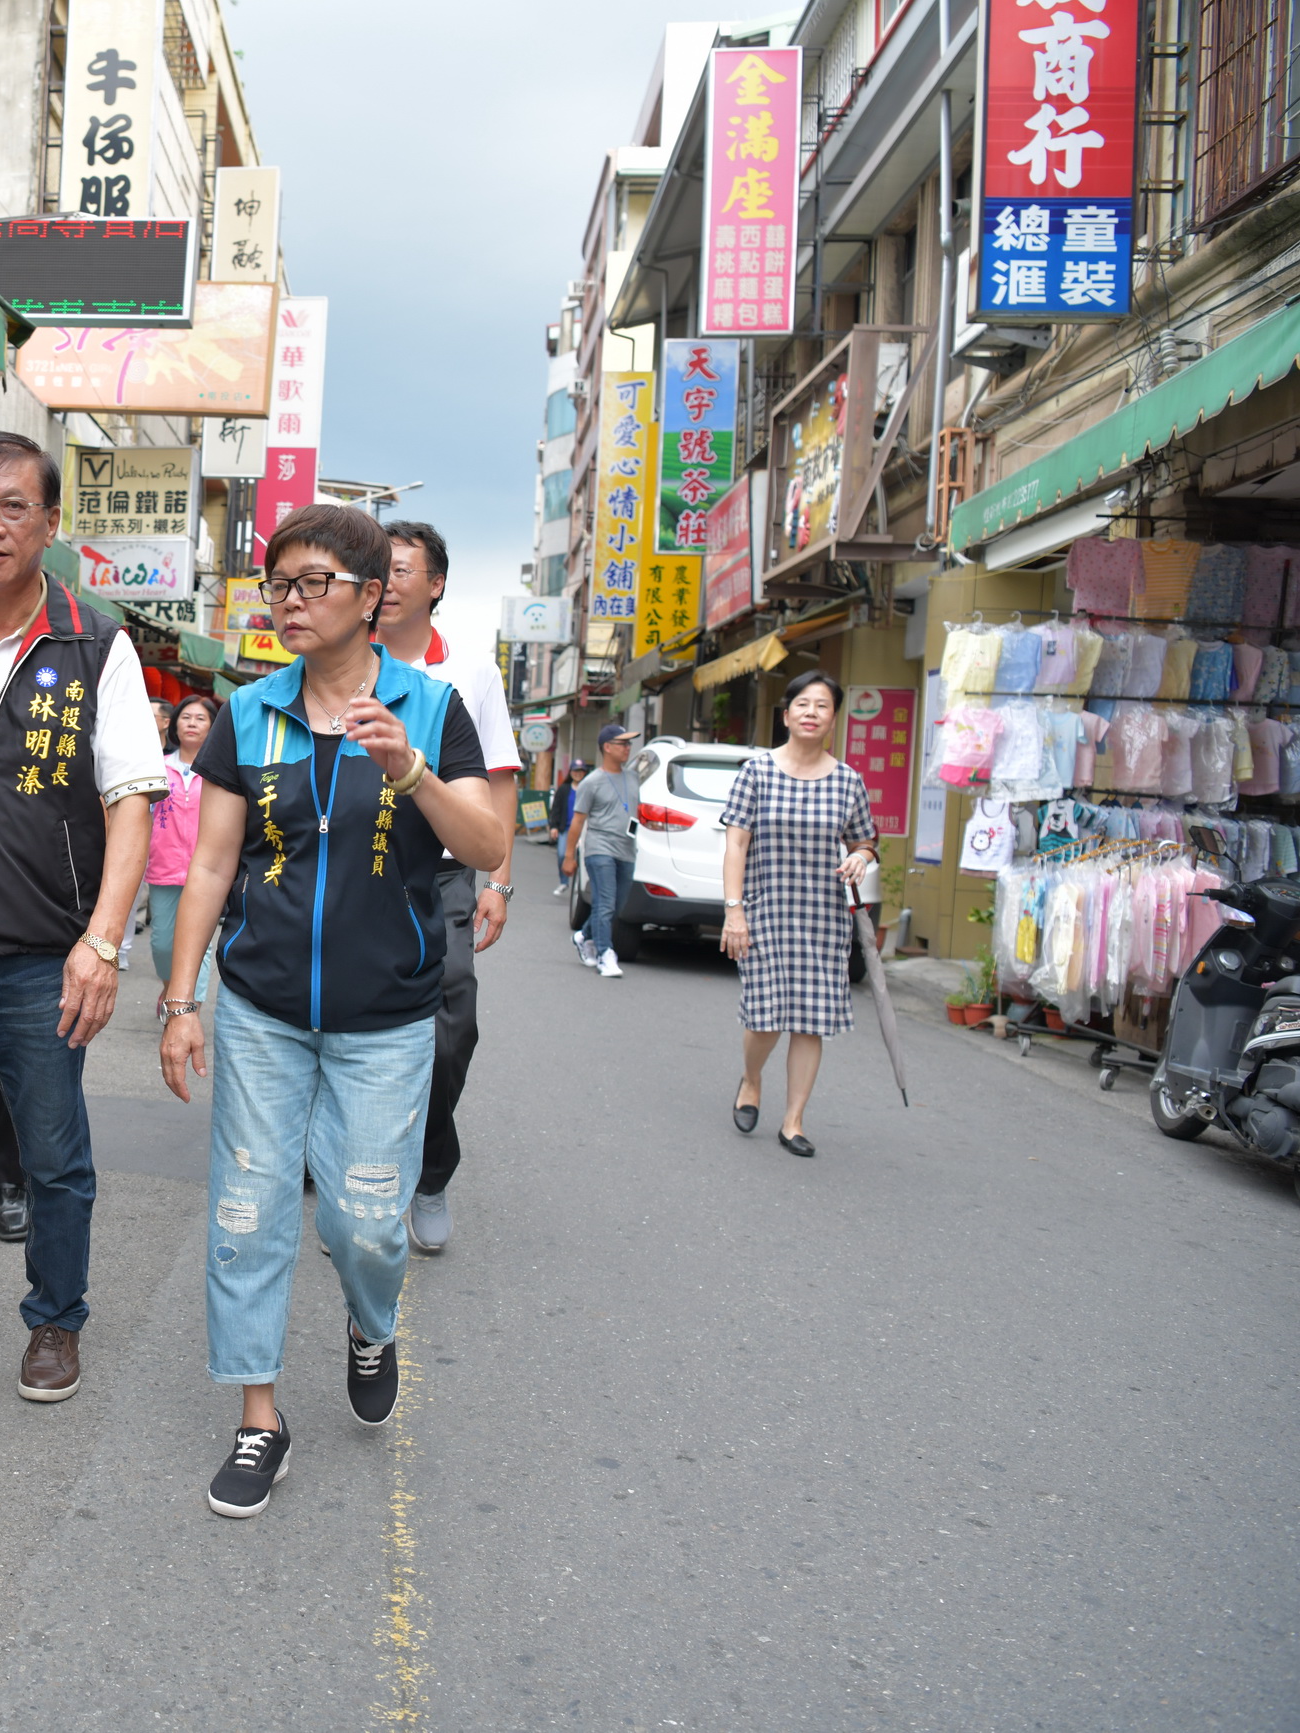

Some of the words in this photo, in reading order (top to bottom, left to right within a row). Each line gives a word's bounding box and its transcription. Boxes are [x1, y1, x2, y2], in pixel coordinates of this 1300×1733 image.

[80, 48, 138, 217] 牛仔服
[721, 53, 788, 220] 金滿座
[1007, 0, 1111, 188] 商行
[1059, 205, 1119, 307] 童裝
[277, 346, 306, 435] 華歌爾
[603, 379, 647, 592] 可愛心情小舖
[673, 345, 721, 549] 天字號茶莊
[78, 490, 188, 514] 范倫鐵諾
[644, 564, 666, 645] 有限公司
[16, 692, 59, 796] 林明溱
[51, 679, 85, 787] 南投縣長
[371, 773, 397, 878] 投縣議員
